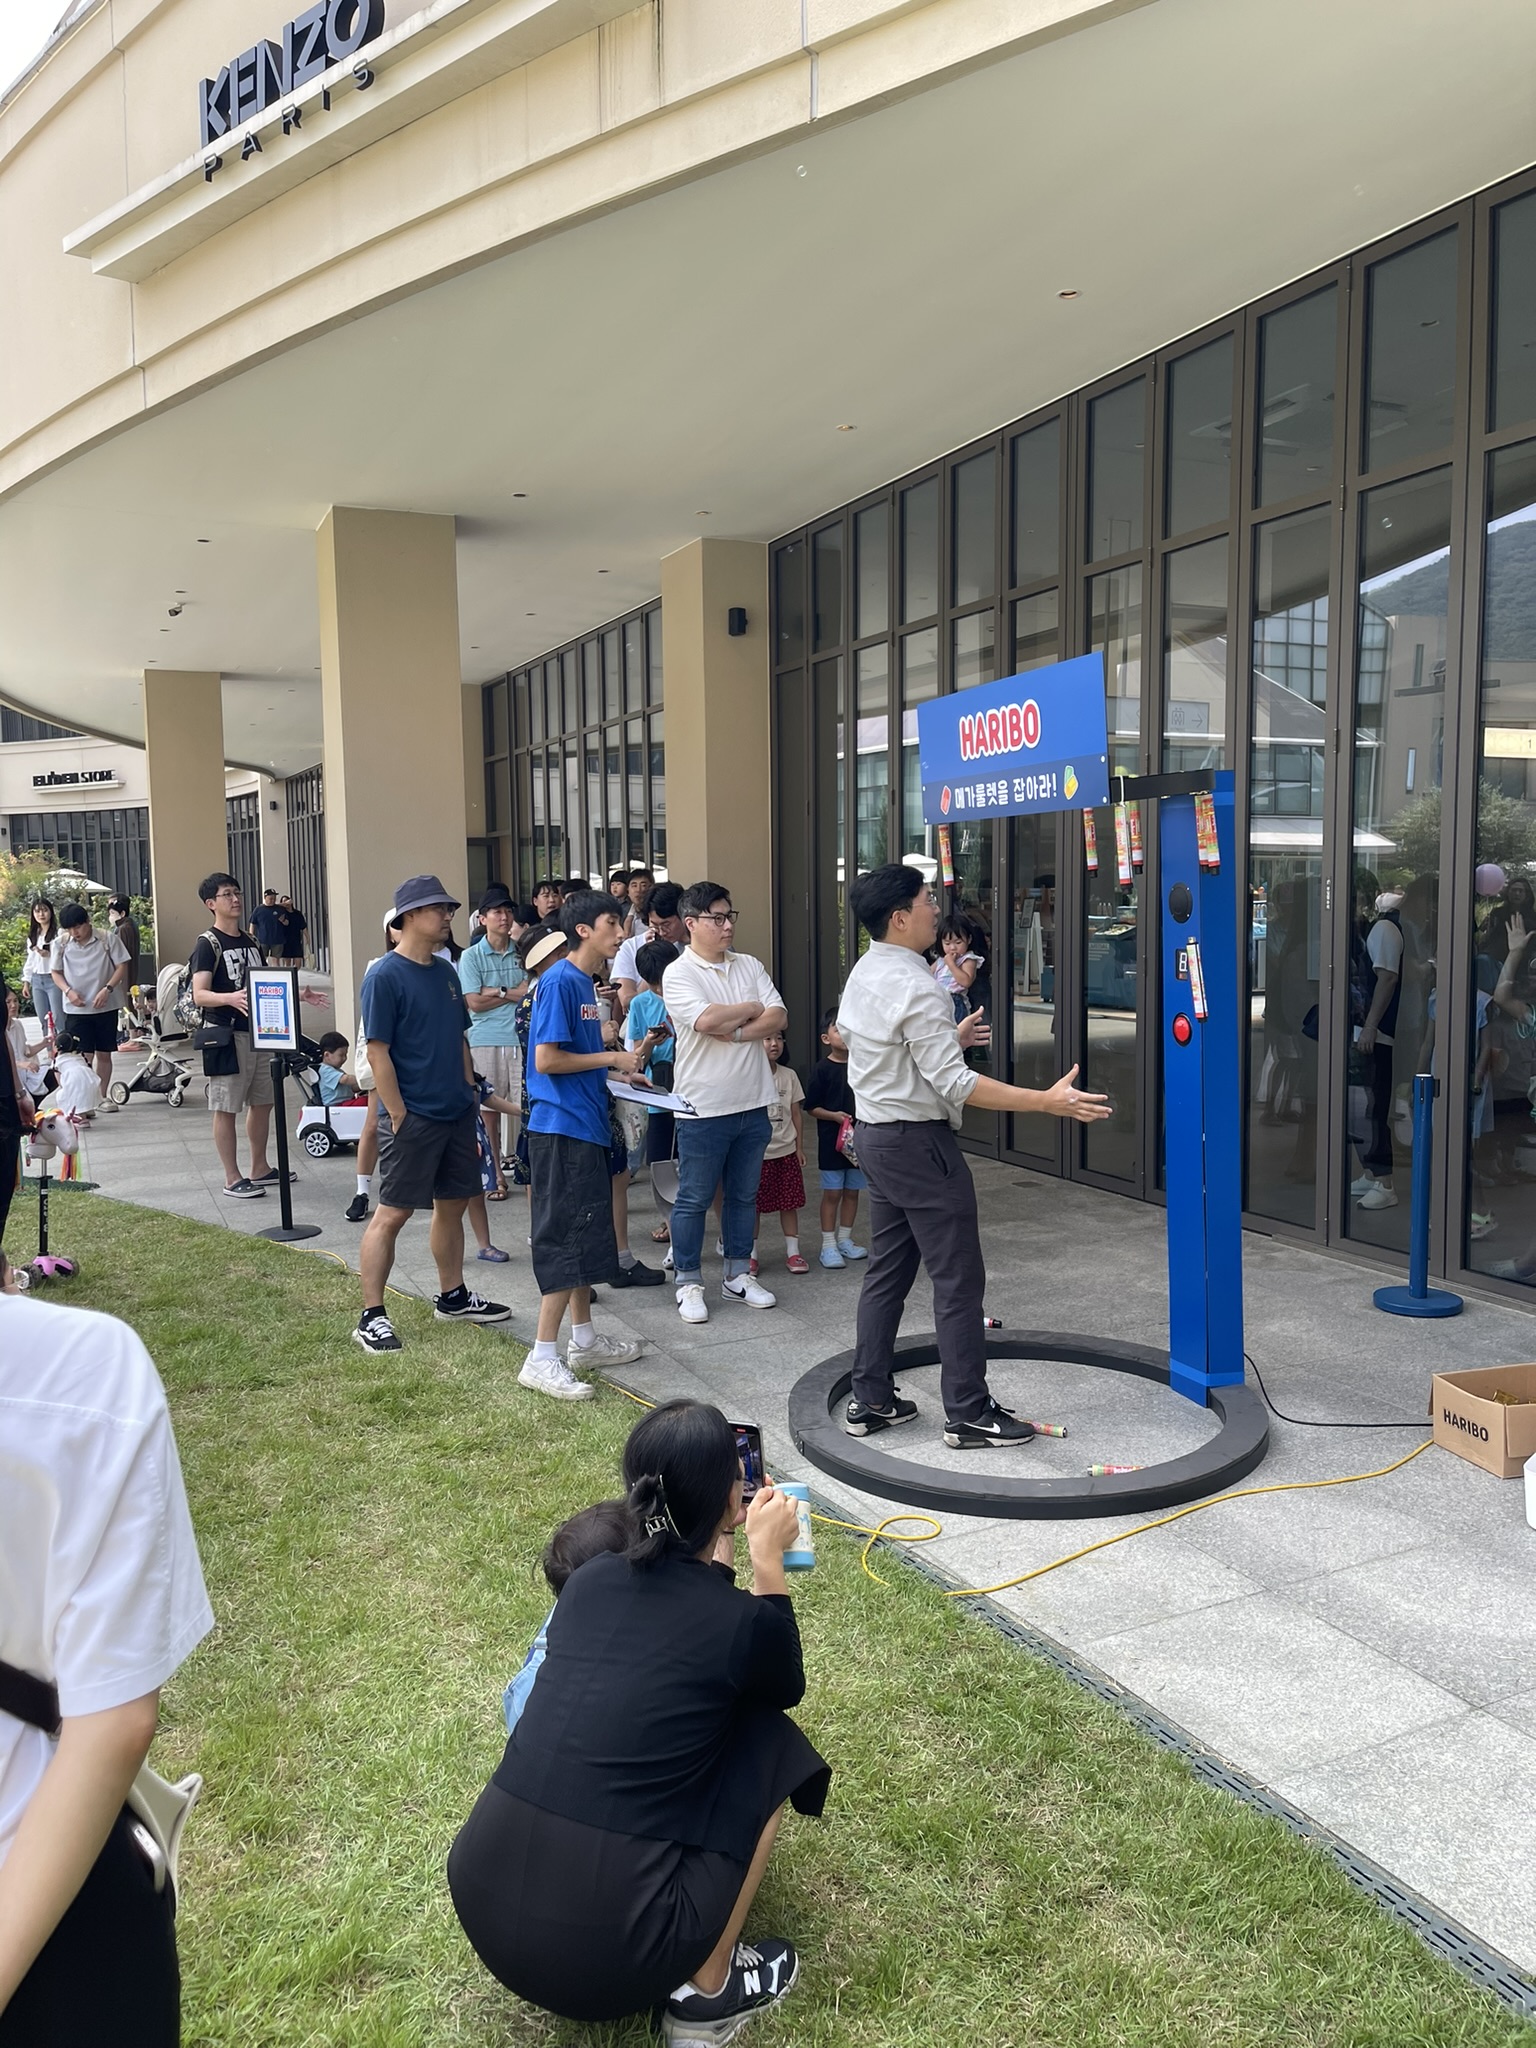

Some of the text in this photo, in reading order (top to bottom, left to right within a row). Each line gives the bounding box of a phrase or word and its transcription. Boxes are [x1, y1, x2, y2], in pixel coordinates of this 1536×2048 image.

[198, 0, 382, 149] KENZO
[203, 58, 375, 183] PARIS
[960, 699, 1041, 761] HARIBO
[80, 769, 116, 783] STORE
[954, 772, 1057, 809] 메가룰렛을 잡아라!
[258, 986, 284, 996] HARIBO
[1443, 1408, 1489, 1443] HARIBO
[743, 1969, 761, 1995] N
